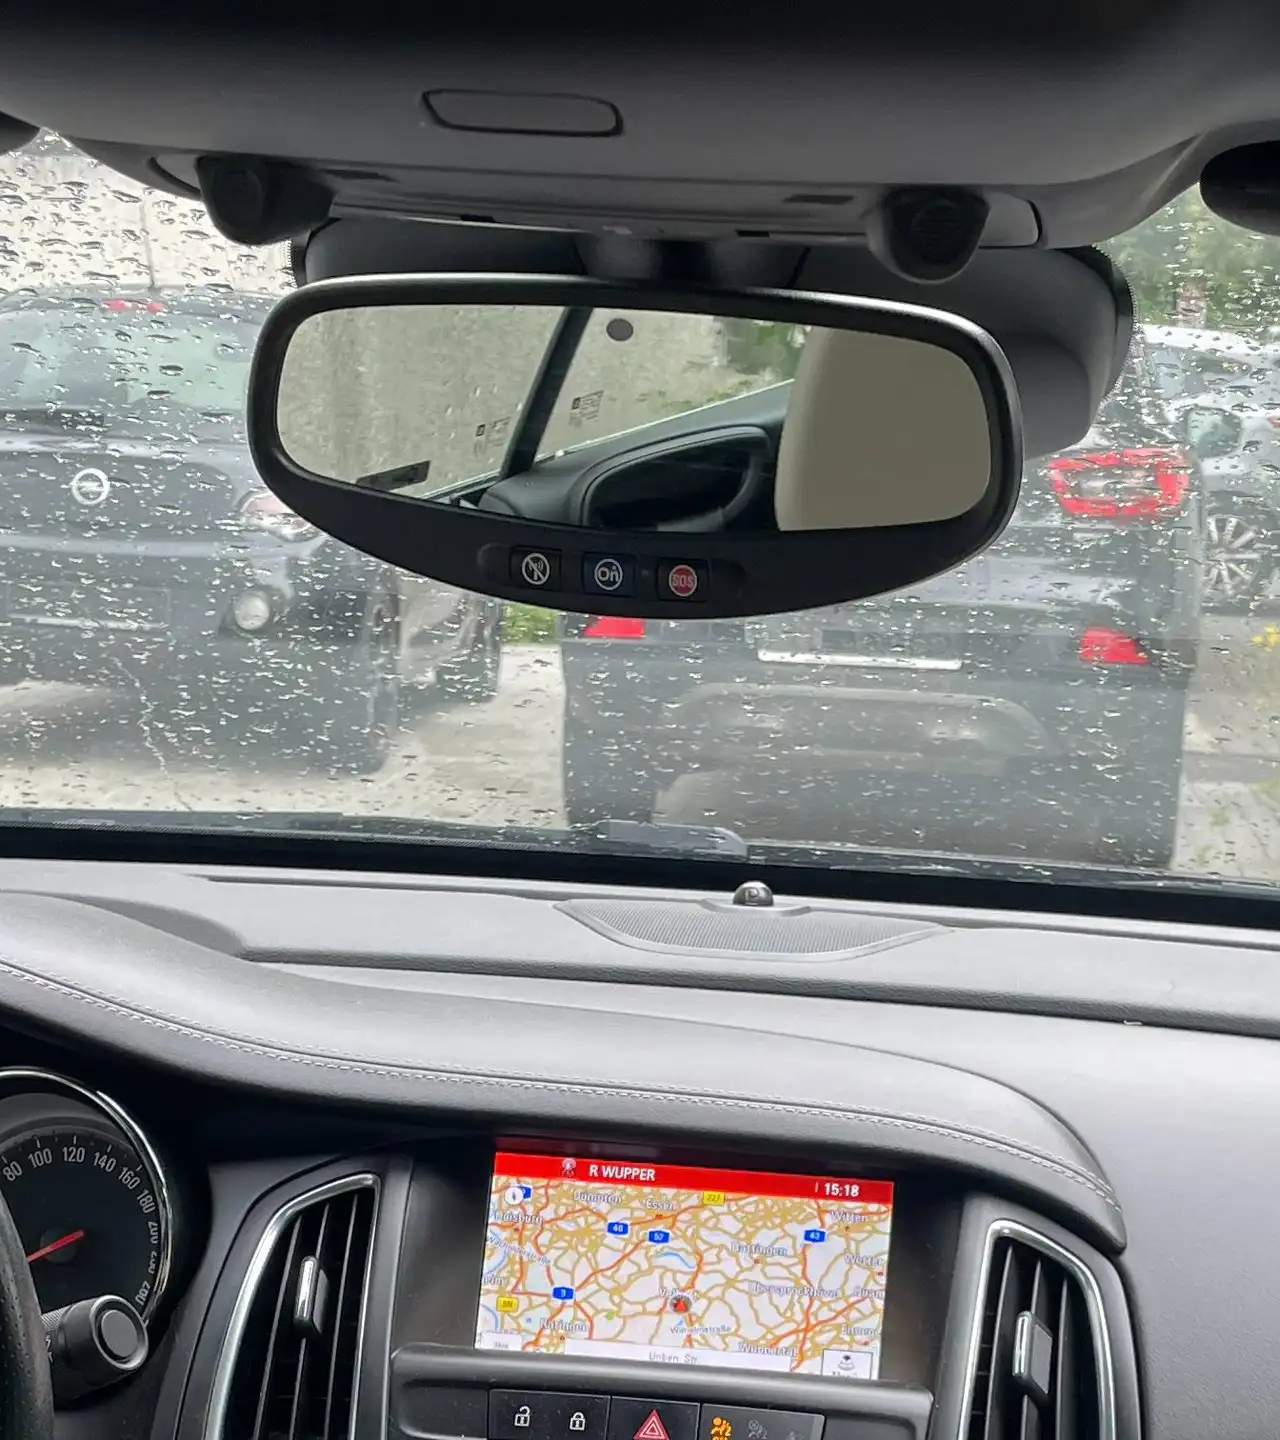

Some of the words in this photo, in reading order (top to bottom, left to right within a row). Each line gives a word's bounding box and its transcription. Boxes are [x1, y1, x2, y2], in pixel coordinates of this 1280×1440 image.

[671, 573, 695, 588] SOS
[28, 1148, 53, 1168] 100
[61, 1146, 86, 1163] 120
[93, 1151, 117, 1173] 140
[2, 1161, 23, 1182] 80
[118, 1166, 141, 1190] 160
[589, 1164, 599, 1177] R
[601, 1165, 656, 1182] WUPPER
[824, 1182, 860, 1198] 15:18
[136, 1189, 156, 1214] 180
